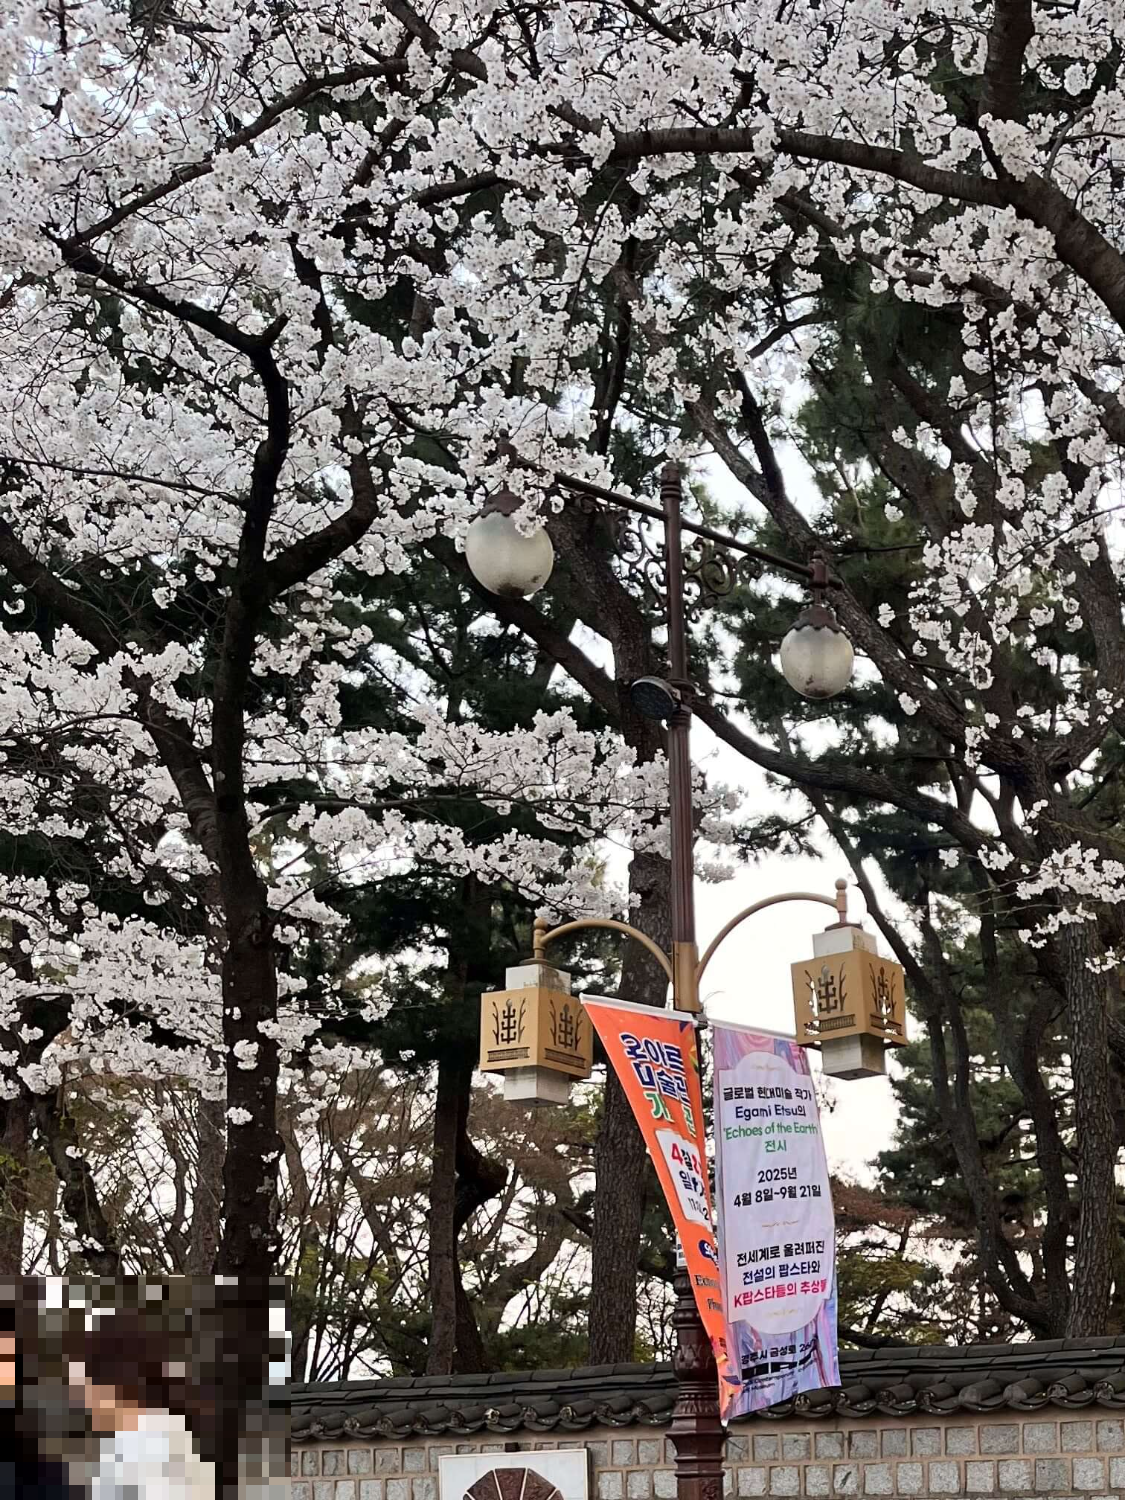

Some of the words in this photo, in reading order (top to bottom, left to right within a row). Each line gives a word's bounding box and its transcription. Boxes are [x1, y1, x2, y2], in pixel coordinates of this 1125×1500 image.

[723, 1087, 754, 1101] 글로벌
[757, 1087, 793, 1099] 현대미술
[795, 1089, 812, 1100] 작가
[735, 1105, 772, 1121] Egami
[774, 1104, 806, 1117] Etsu의
[765, 1122, 775, 1136] of
[777, 1122, 792, 1133] the
[765, 1140, 787, 1152] 전시
[758, 1167, 797, 1183] 2025년
[734, 1192, 752, 1207] 4월
[755, 1186, 797, 1203] 8일~9월
[800, 1185, 822, 1197] 21일
[736, 1246, 780, 1267] 전세계로
[783, 1240, 825, 1257] 울려퍼진
[743, 1266, 775, 1285] 전설의
[779, 1260, 820, 1278] 팝스타와
[734, 1282, 797, 1308] K팝스타들의
